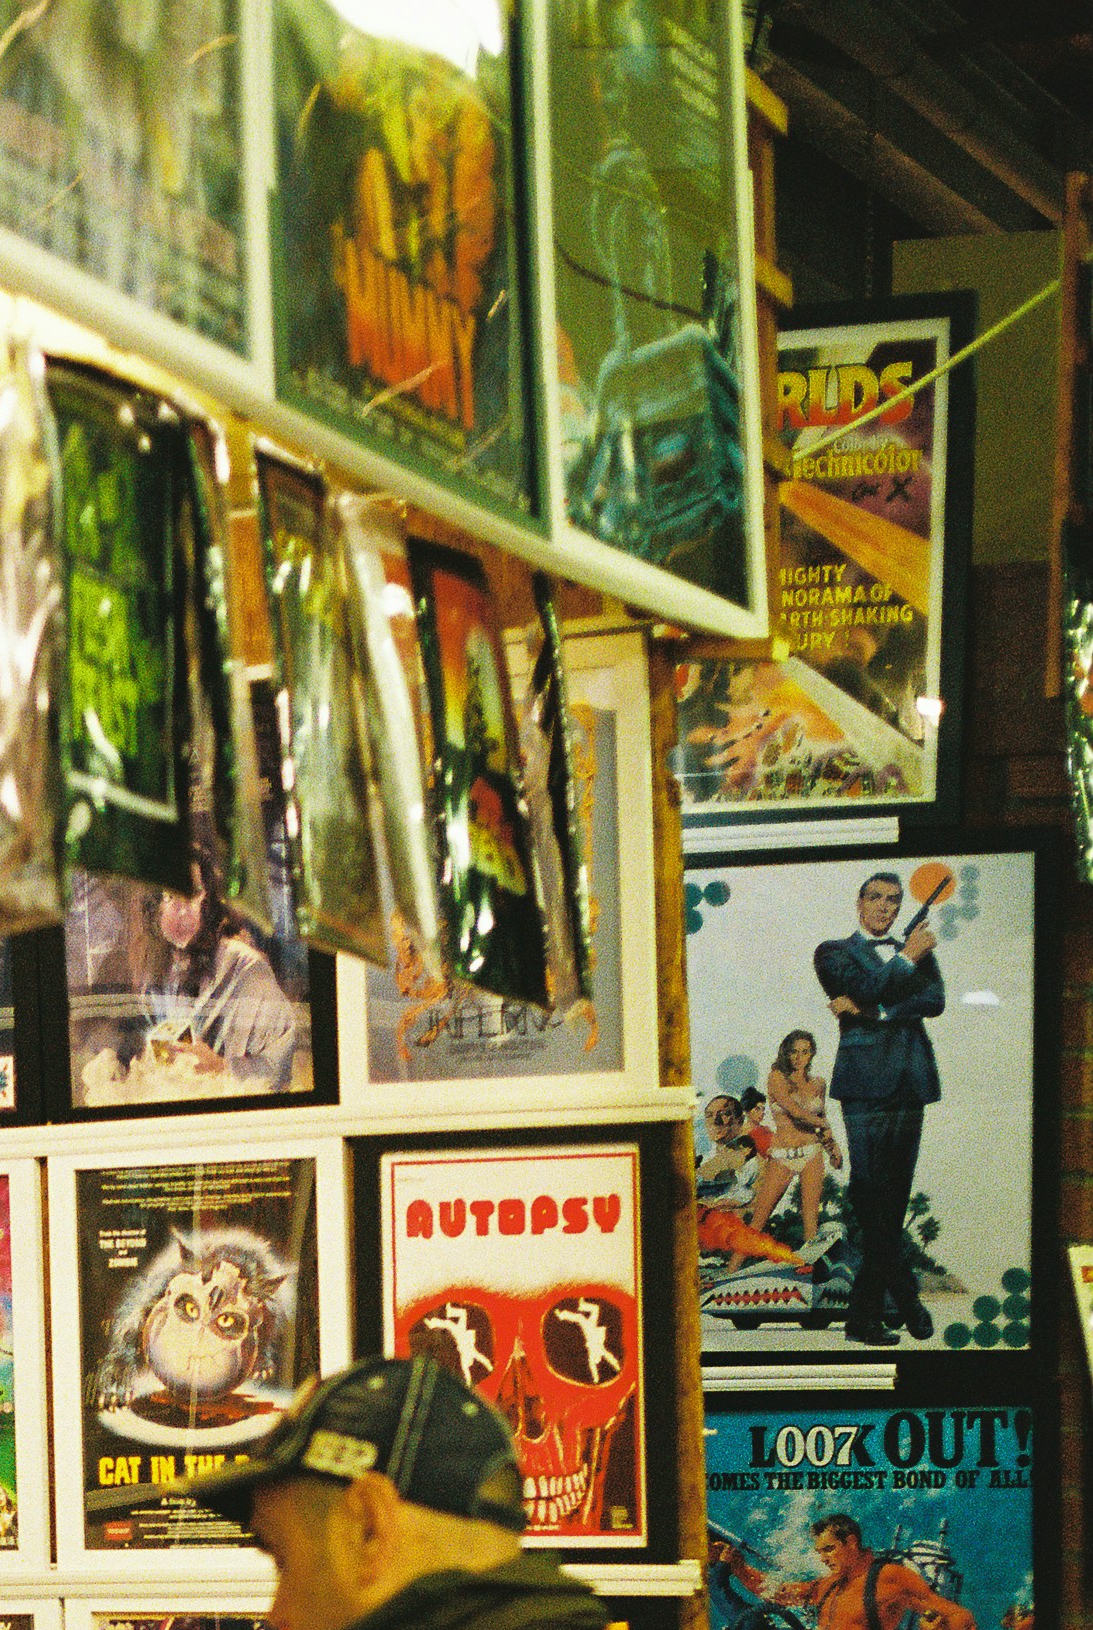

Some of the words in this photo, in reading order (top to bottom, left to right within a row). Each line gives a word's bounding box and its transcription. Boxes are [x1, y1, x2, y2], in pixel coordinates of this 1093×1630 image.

[781, 585, 867, 607] NORAMA
[406, 1193, 621, 1239] AUTOPSY
[884, 1410, 1033, 1469] OUT!
[98, 1455, 141, 1486] CAT
[150, 1455, 176, 1485] IN
[763, 1471, 805, 1491] THE
[807, 1470, 886, 1491] BIGGEST
[892, 1470, 947, 1490] BOND
[957, 1470, 981, 1490] OF
